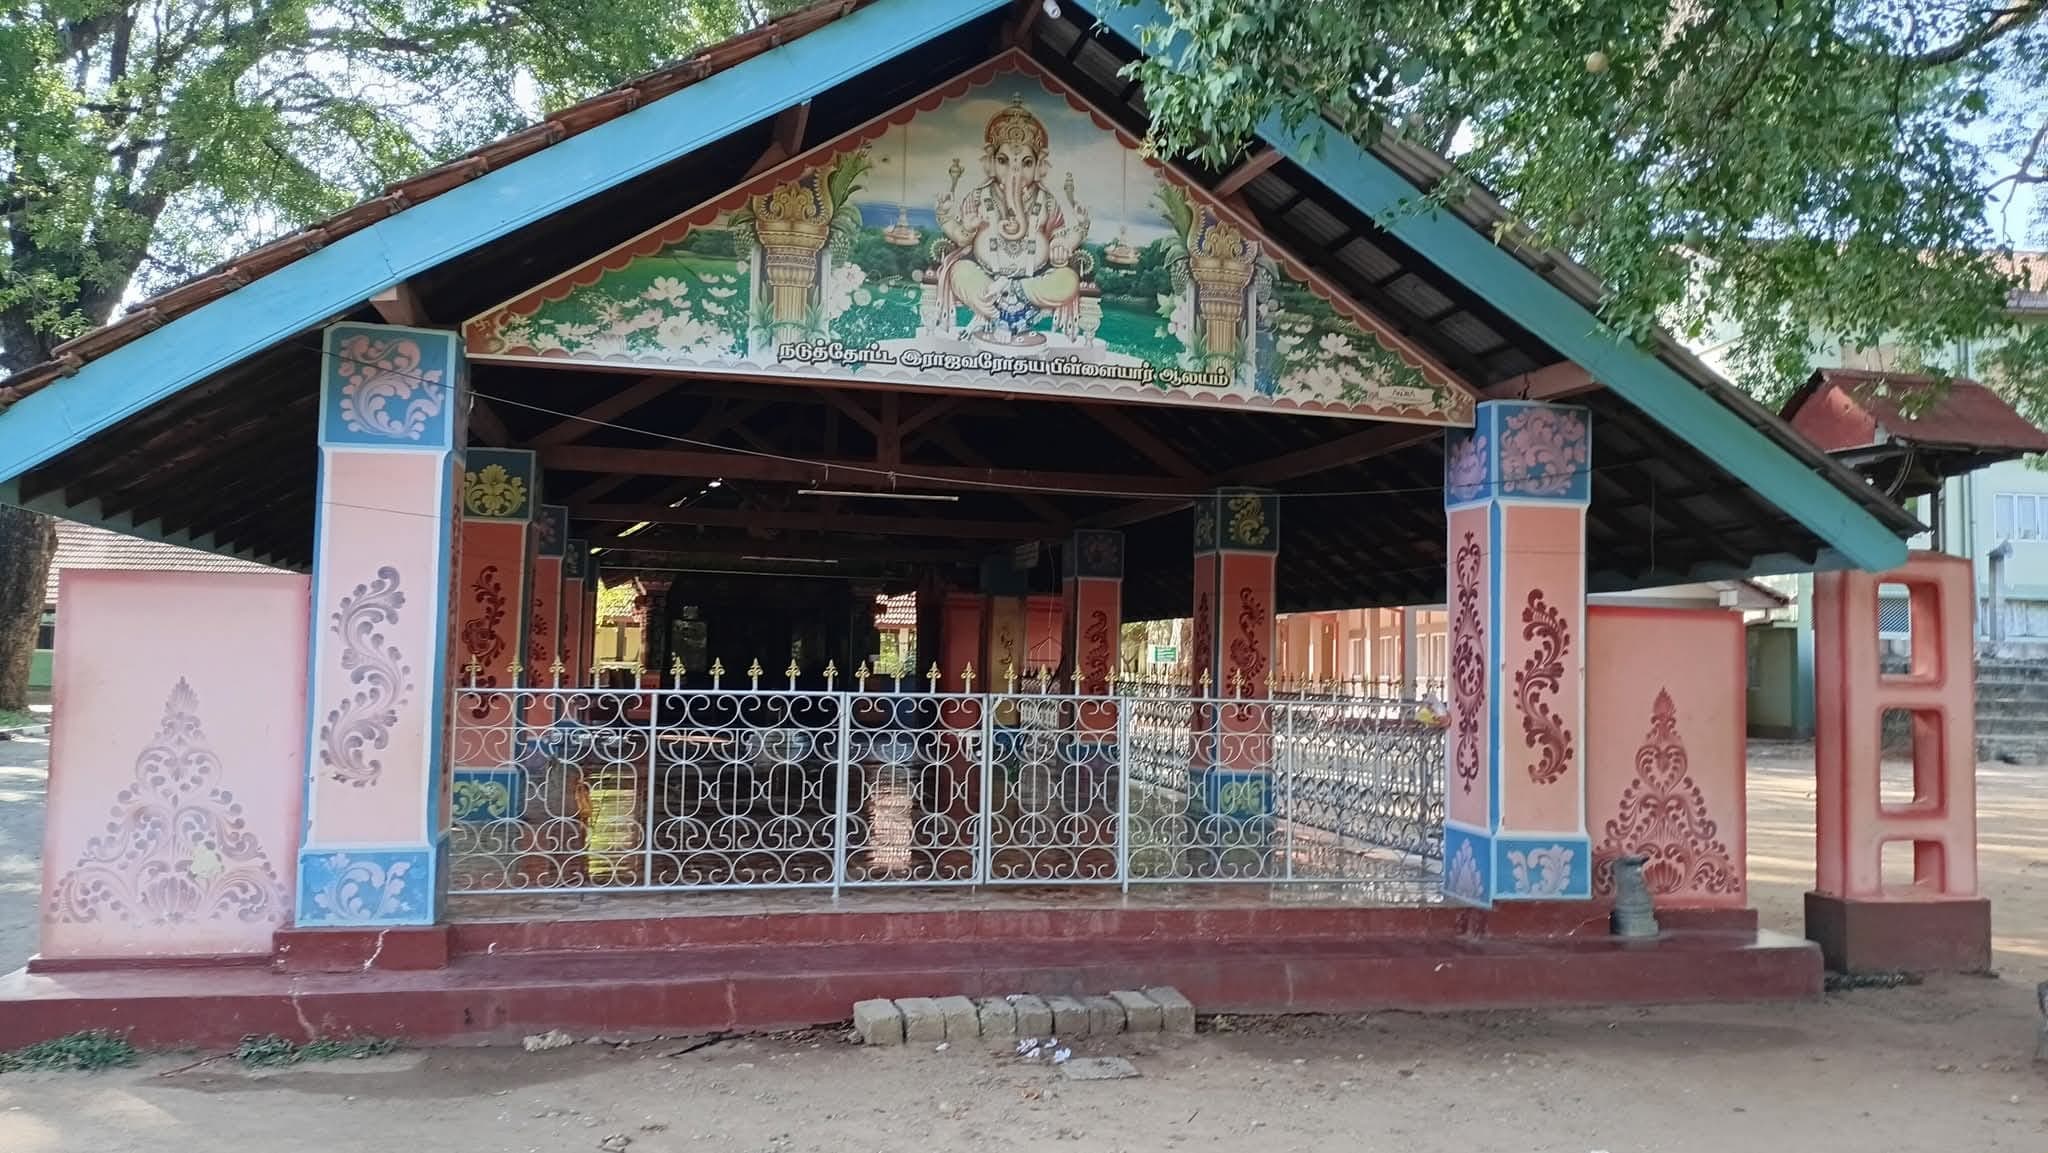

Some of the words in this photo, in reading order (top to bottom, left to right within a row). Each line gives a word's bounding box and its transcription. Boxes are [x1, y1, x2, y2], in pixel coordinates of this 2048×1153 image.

[778, 338, 896, 366] நடுத்தோட்ட
[1048, 355, 1154, 384] பிள்ளையார்
[1159, 366, 1230, 387] ஆலயம்
